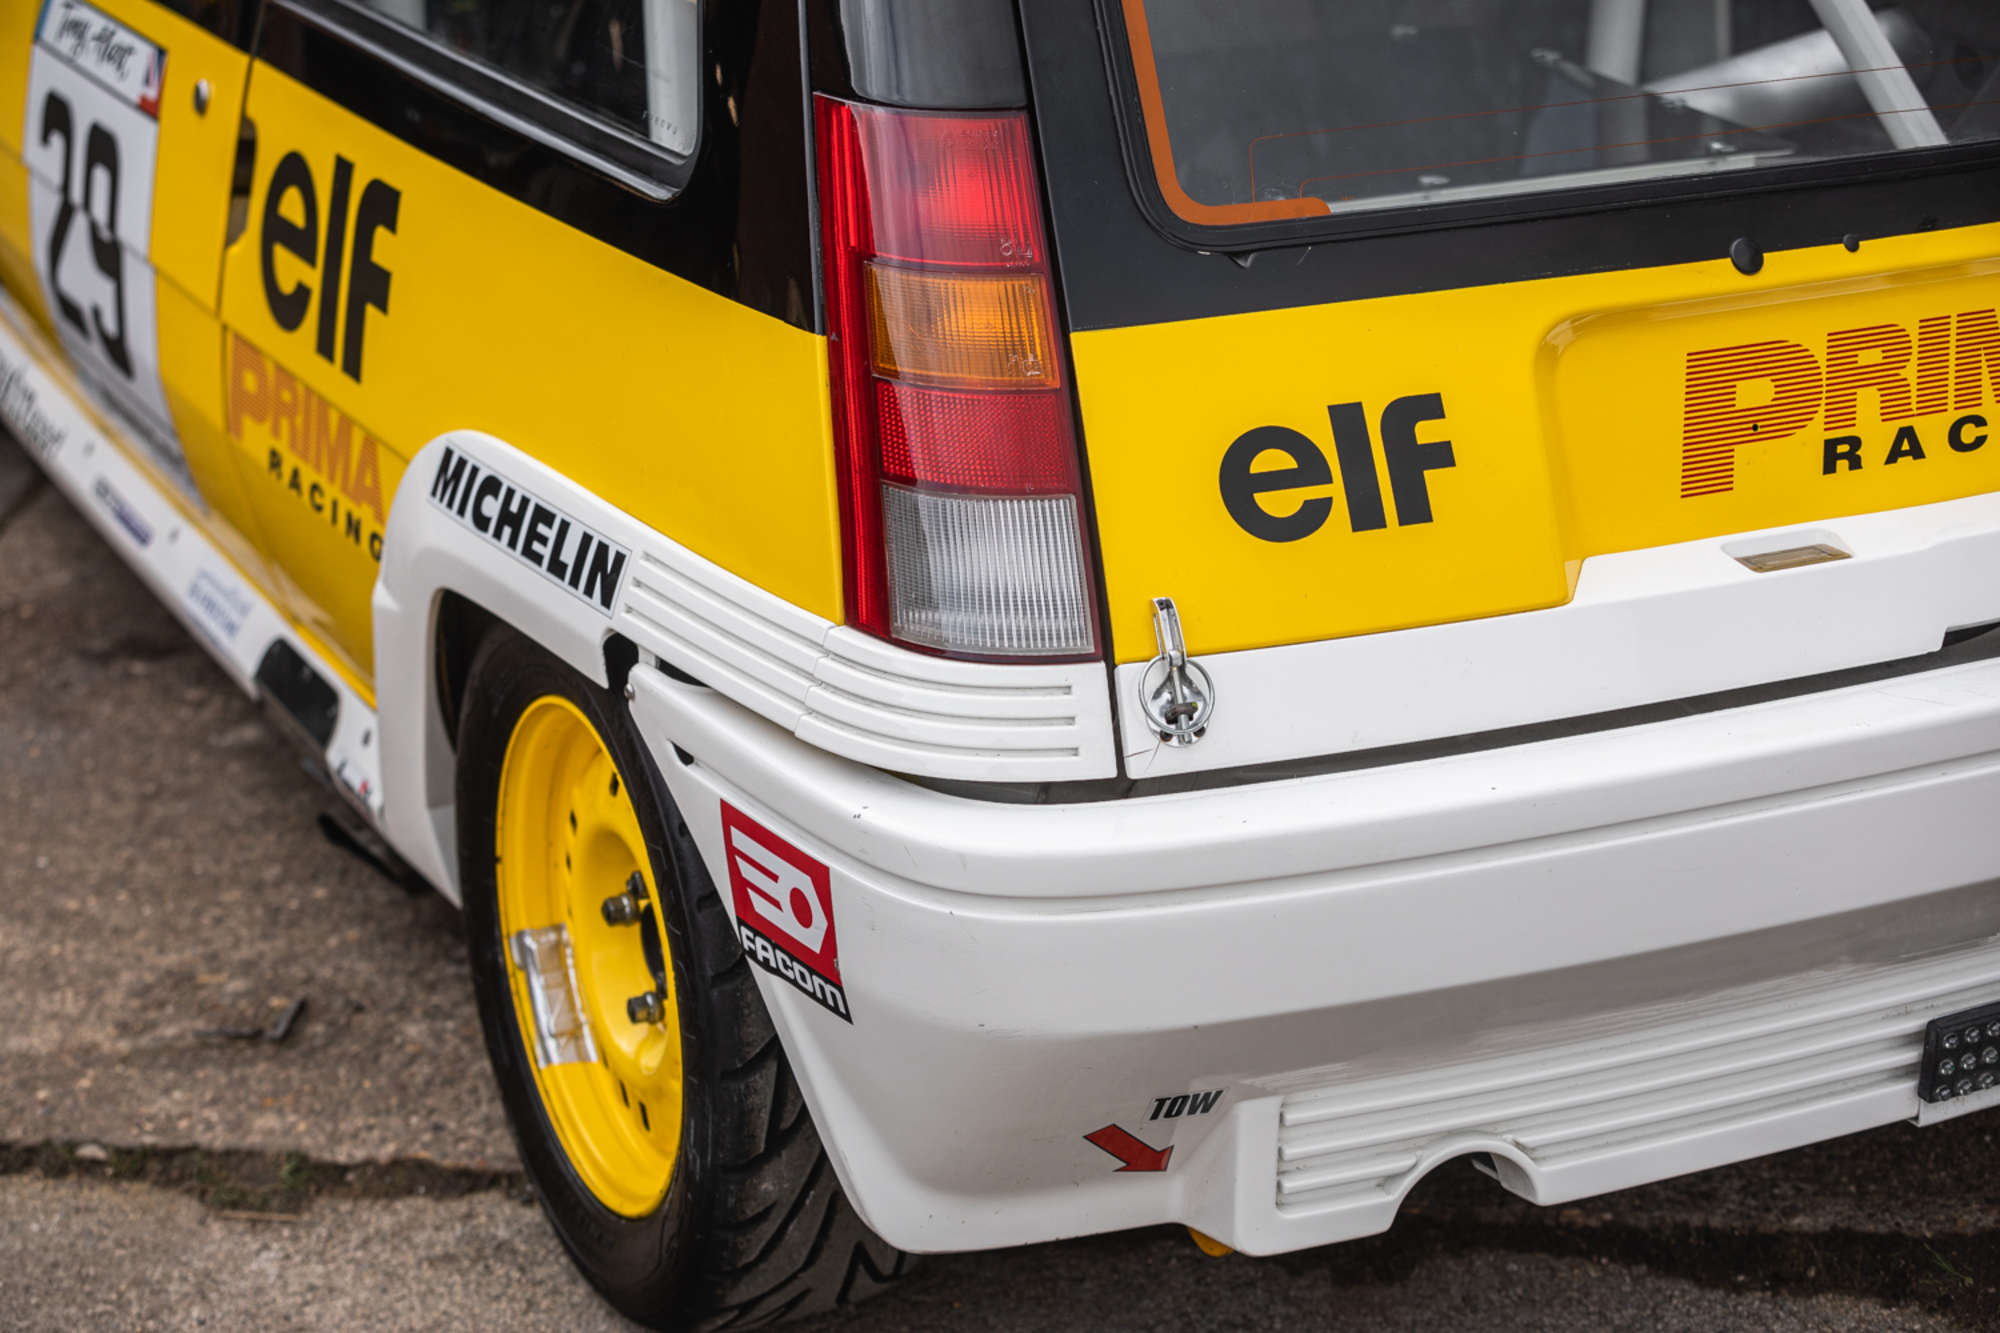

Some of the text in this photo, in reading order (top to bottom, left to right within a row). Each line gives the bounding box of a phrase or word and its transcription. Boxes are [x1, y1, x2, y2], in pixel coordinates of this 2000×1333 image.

[41, 90, 135, 382] 29
[261, 150, 402, 385] elf
[228, 331, 386, 526] PRIMA
[1219, 392, 1457, 543] elf
[1822, 414, 1988, 475] RAC
[430, 445, 627, 611] MICHELIN
[1149, 1089, 1224, 1121] TOW
